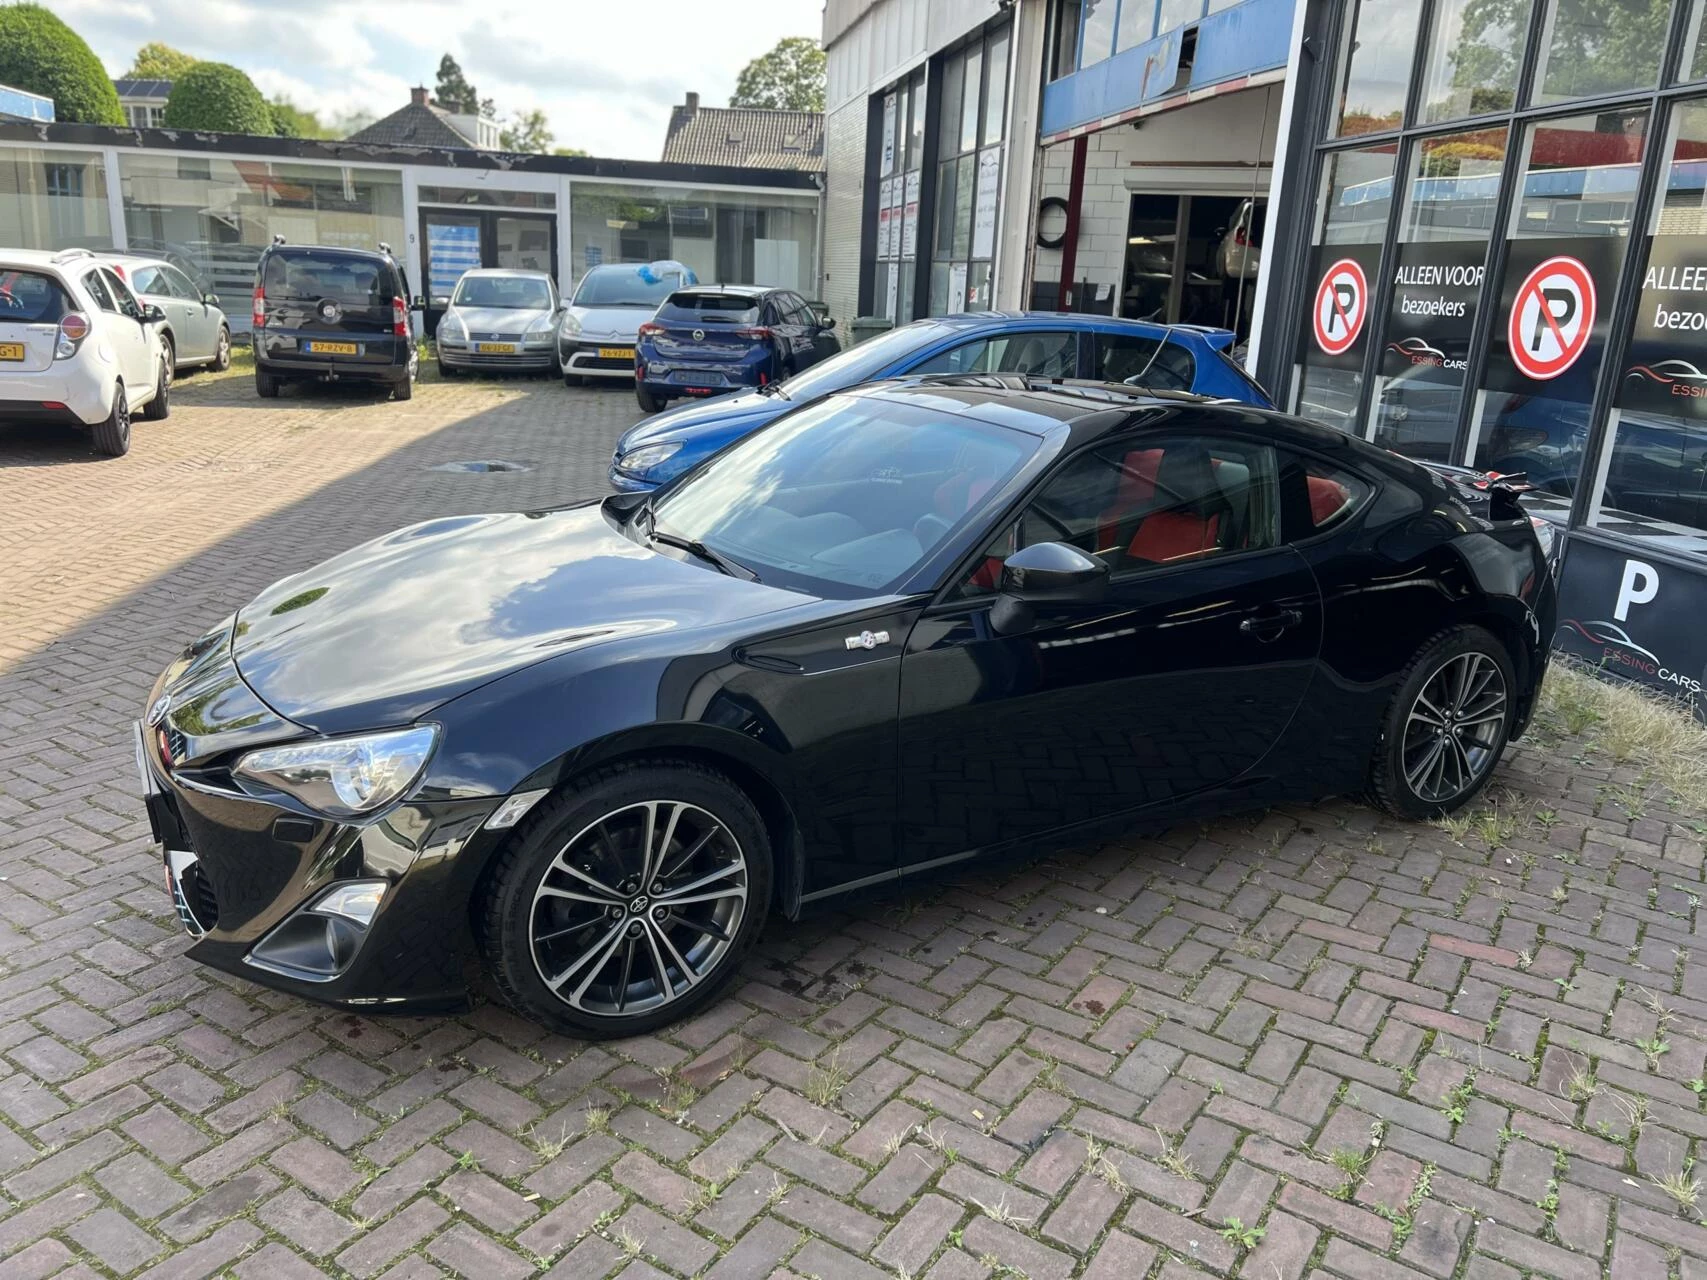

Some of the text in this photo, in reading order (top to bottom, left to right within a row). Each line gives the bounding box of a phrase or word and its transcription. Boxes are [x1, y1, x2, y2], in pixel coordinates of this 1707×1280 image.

[1394, 265, 1485, 286] ALLEEN VOOR
[1642, 265, 1707, 291] ALLEE
[1401, 293, 1466, 317] bezoekers
[1653, 303, 1707, 331] bezo
[1411, 355, 1468, 370] ESSING CARS
[1671, 384, 1707, 398] ESSI
[1613, 559, 1660, 622] P
[1603, 647, 1701, 692] ESSING CARS
